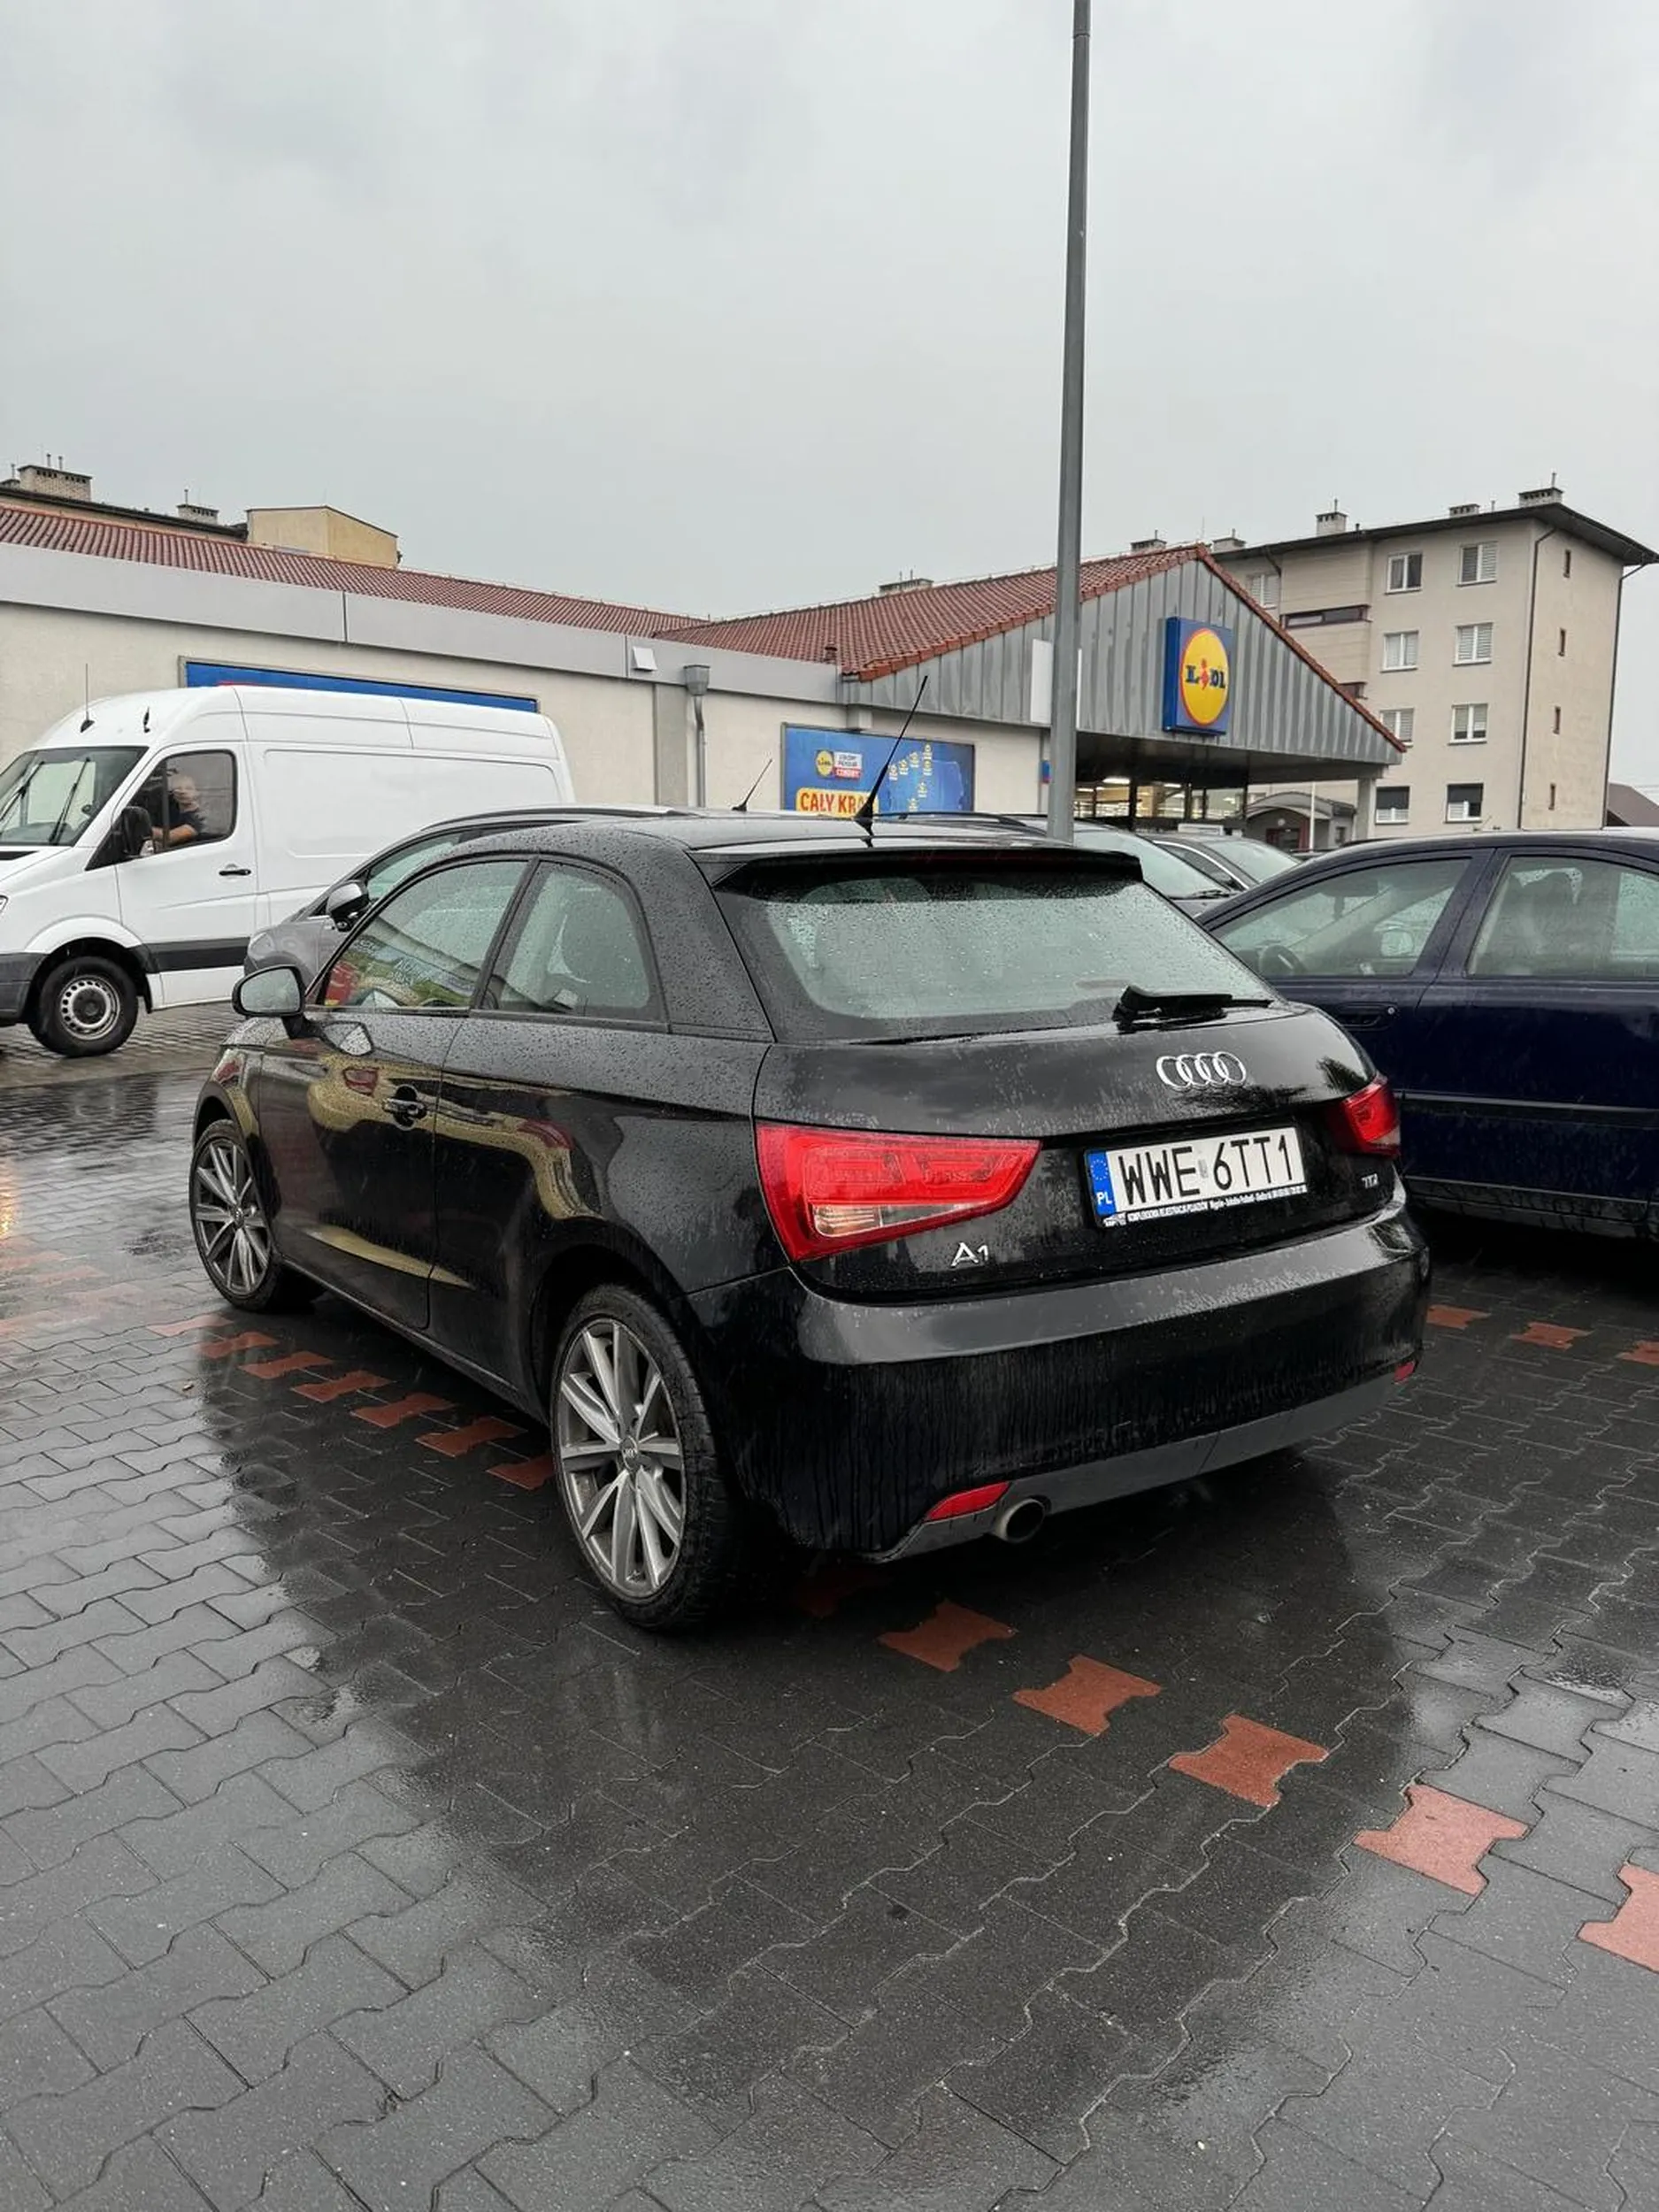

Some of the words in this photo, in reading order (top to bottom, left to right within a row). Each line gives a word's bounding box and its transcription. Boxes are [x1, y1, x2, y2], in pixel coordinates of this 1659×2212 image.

[1118, 1147, 1200, 1205] WWE
[1213, 1135, 1292, 1191] 6TT1
[1096, 1192, 1112, 1205] PL
[951, 1242, 988, 1266] A1
